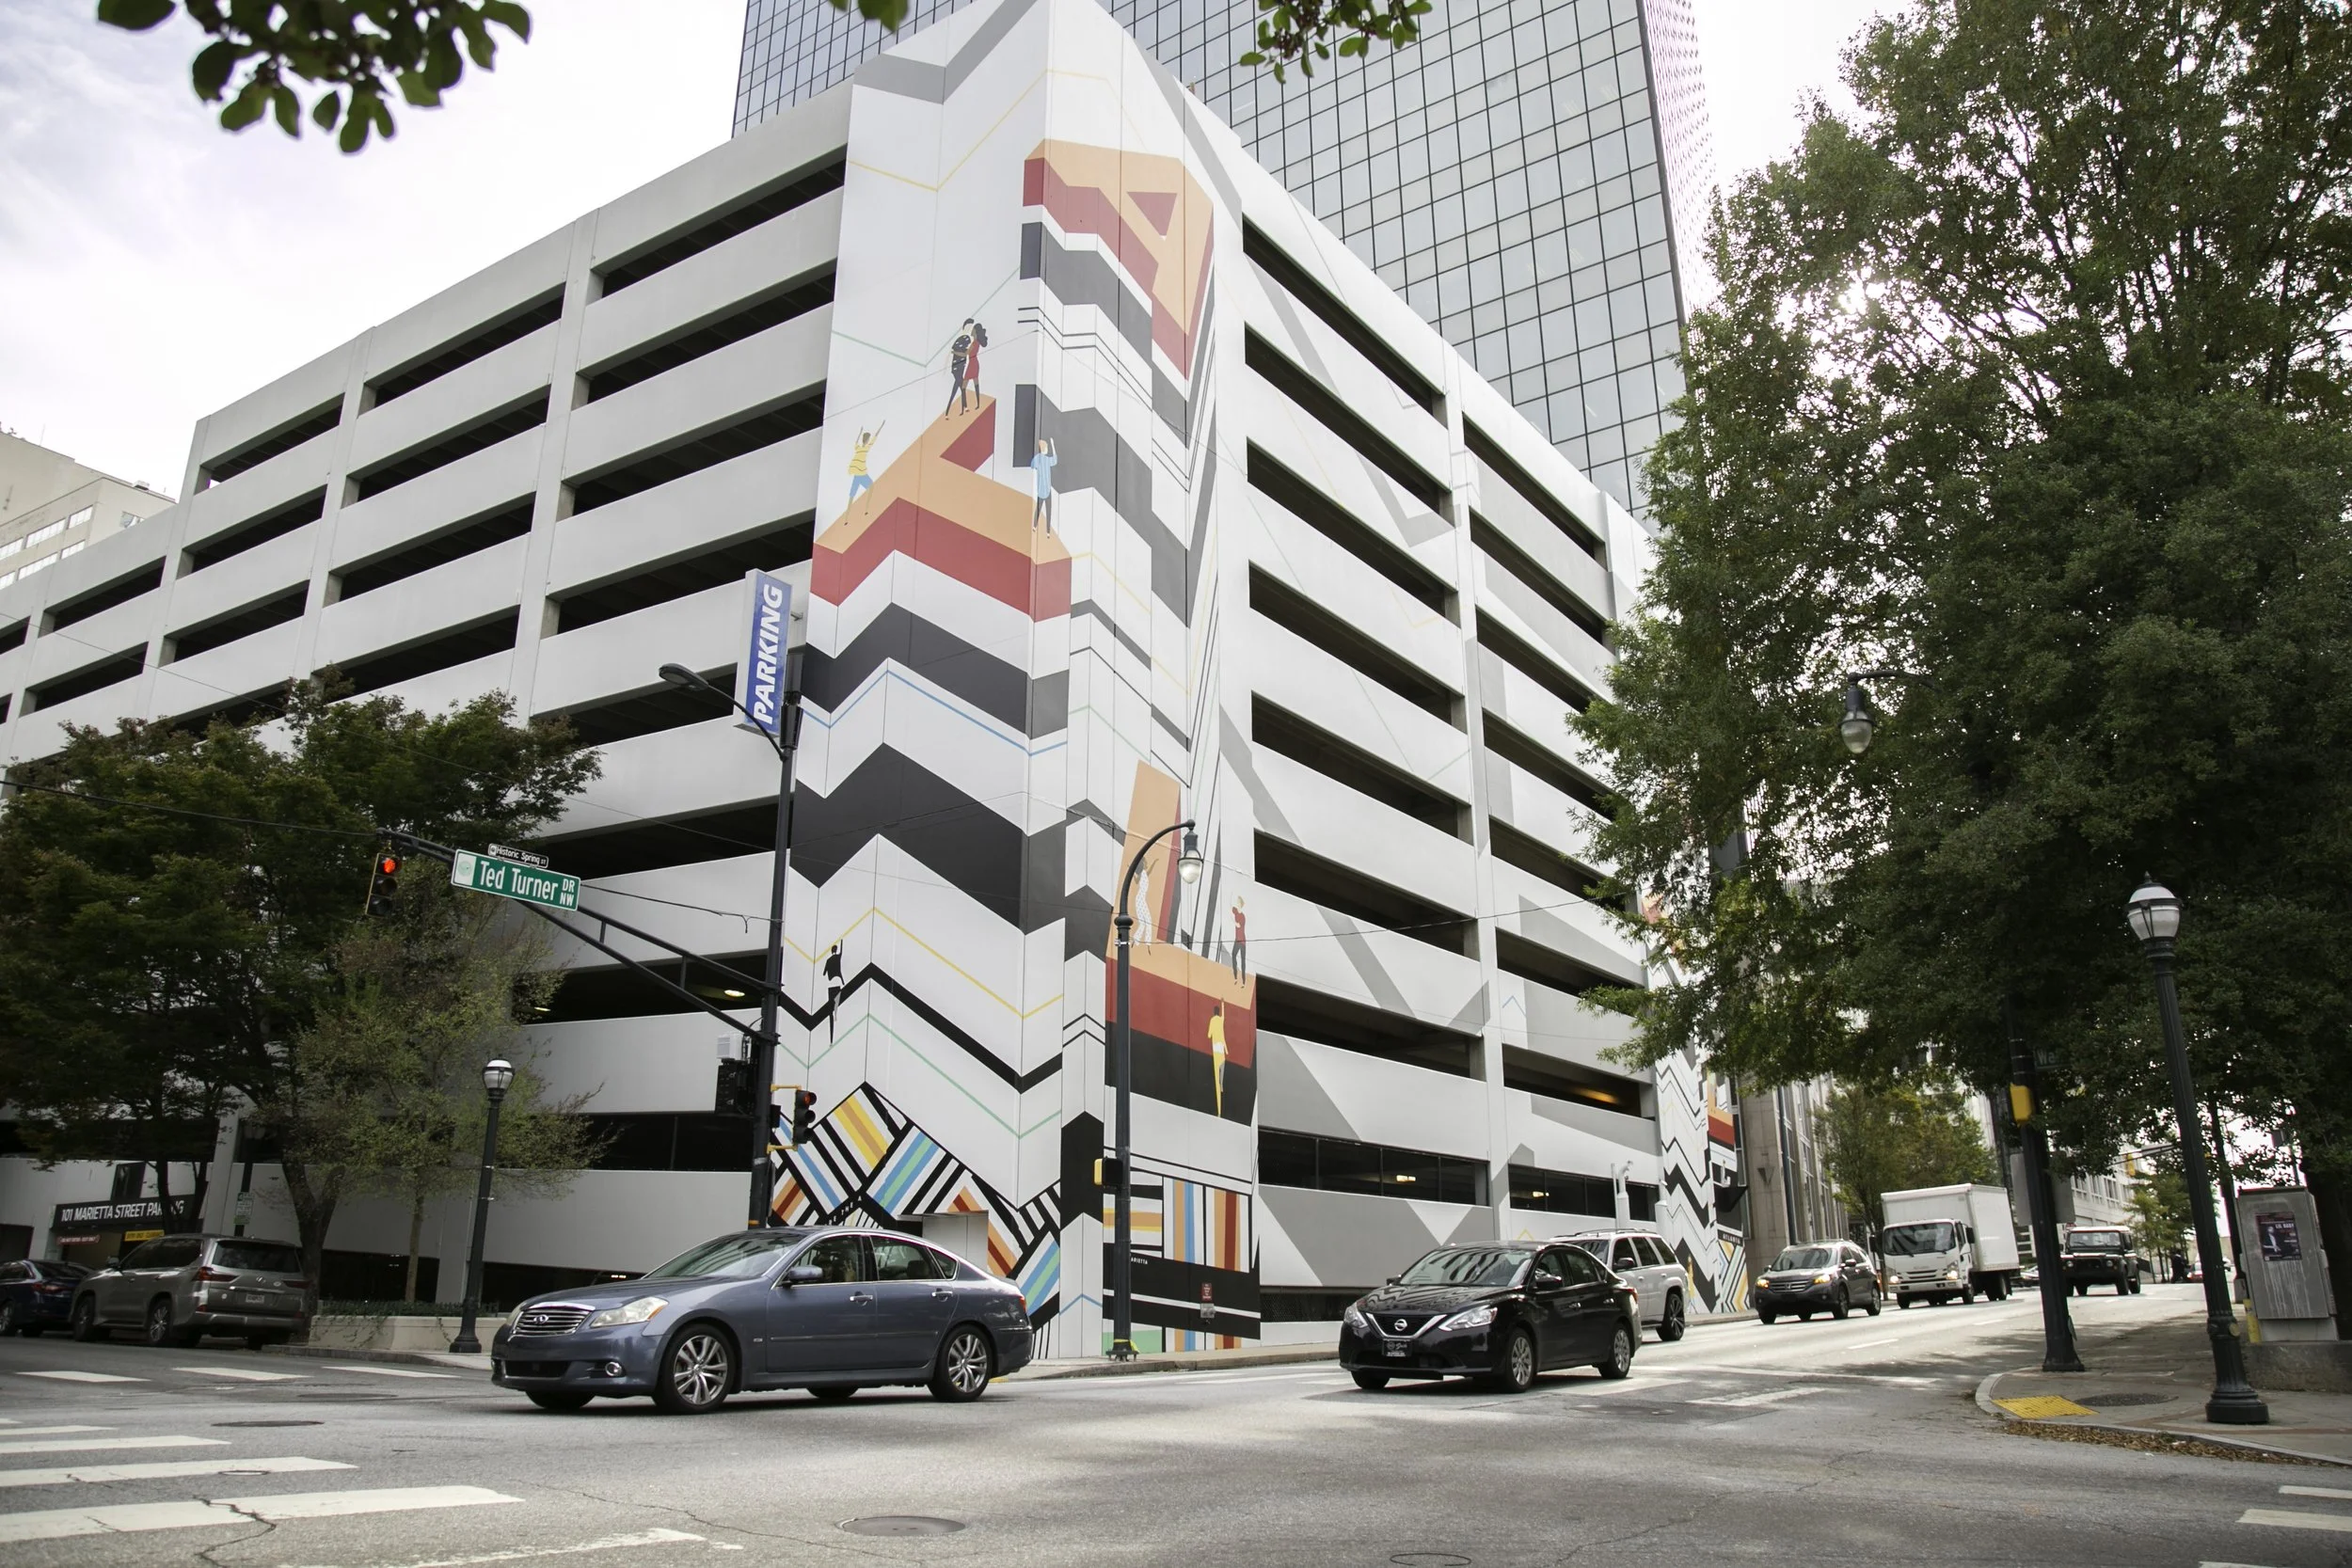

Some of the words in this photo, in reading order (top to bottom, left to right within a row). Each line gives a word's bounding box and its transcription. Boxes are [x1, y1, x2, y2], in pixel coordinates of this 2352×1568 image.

[754, 583, 783, 725] PARKING
[496, 846, 519, 859] Historic
[520, 852, 541, 865] Spring
[480, 860, 505, 890] Ted
[511, 867, 559, 901] Turner
[562, 879, 576, 893] DR
[560, 893, 575, 907] NW
[61, 1208, 73, 1222] 101
[73, 1205, 114, 1222] MARIETTA
[114, 1202, 147, 1219] STREET
